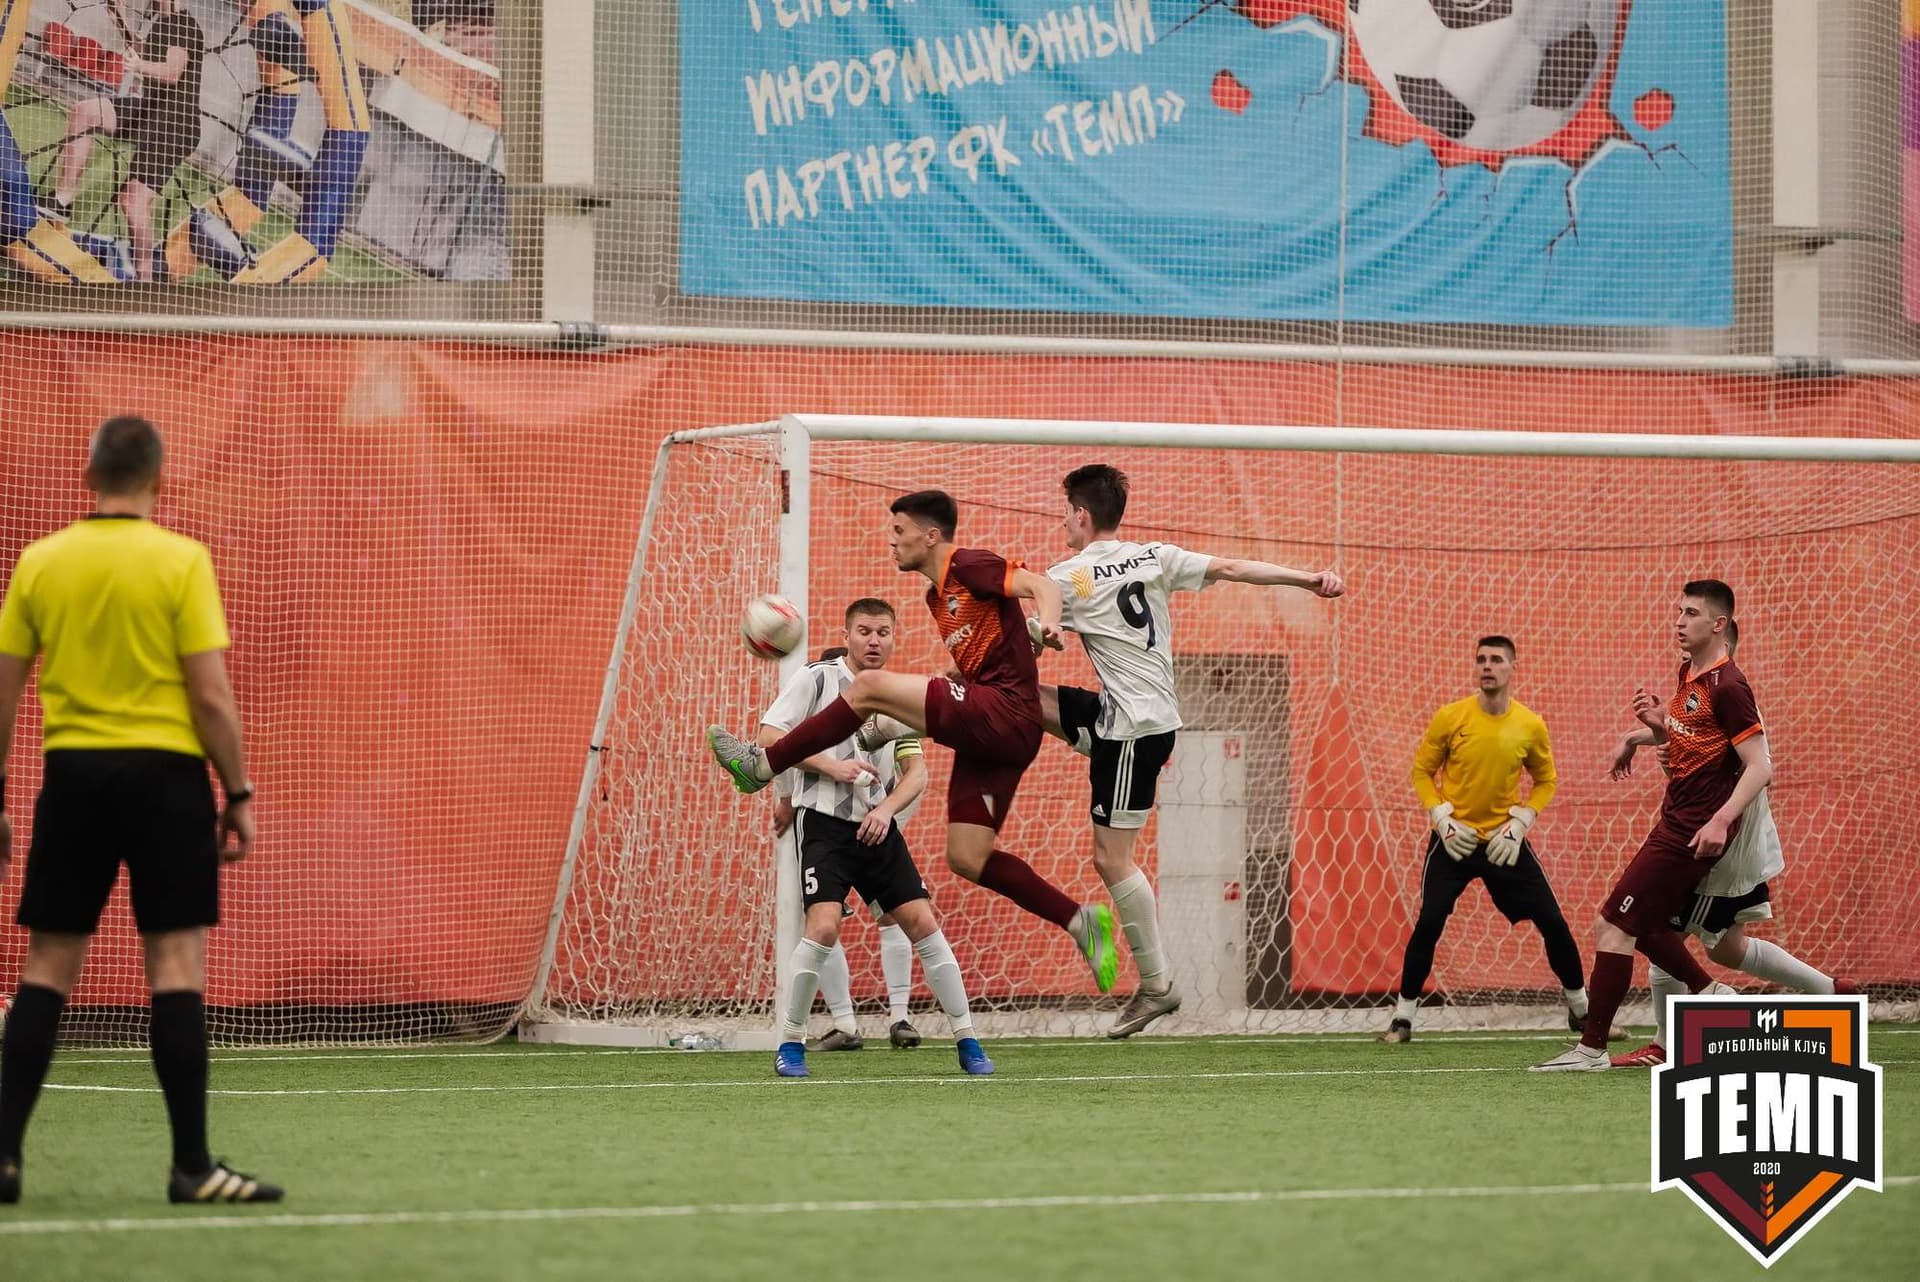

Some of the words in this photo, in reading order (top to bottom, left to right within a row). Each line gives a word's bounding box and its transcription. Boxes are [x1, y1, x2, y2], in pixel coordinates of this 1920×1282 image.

[744, 138, 936, 229] ПАРТНЕР
[947, 115, 1022, 182] ФК
[1116, 581, 1156, 652] 9
[805, 866, 819, 895] 5
[1619, 895, 1634, 913] 9
